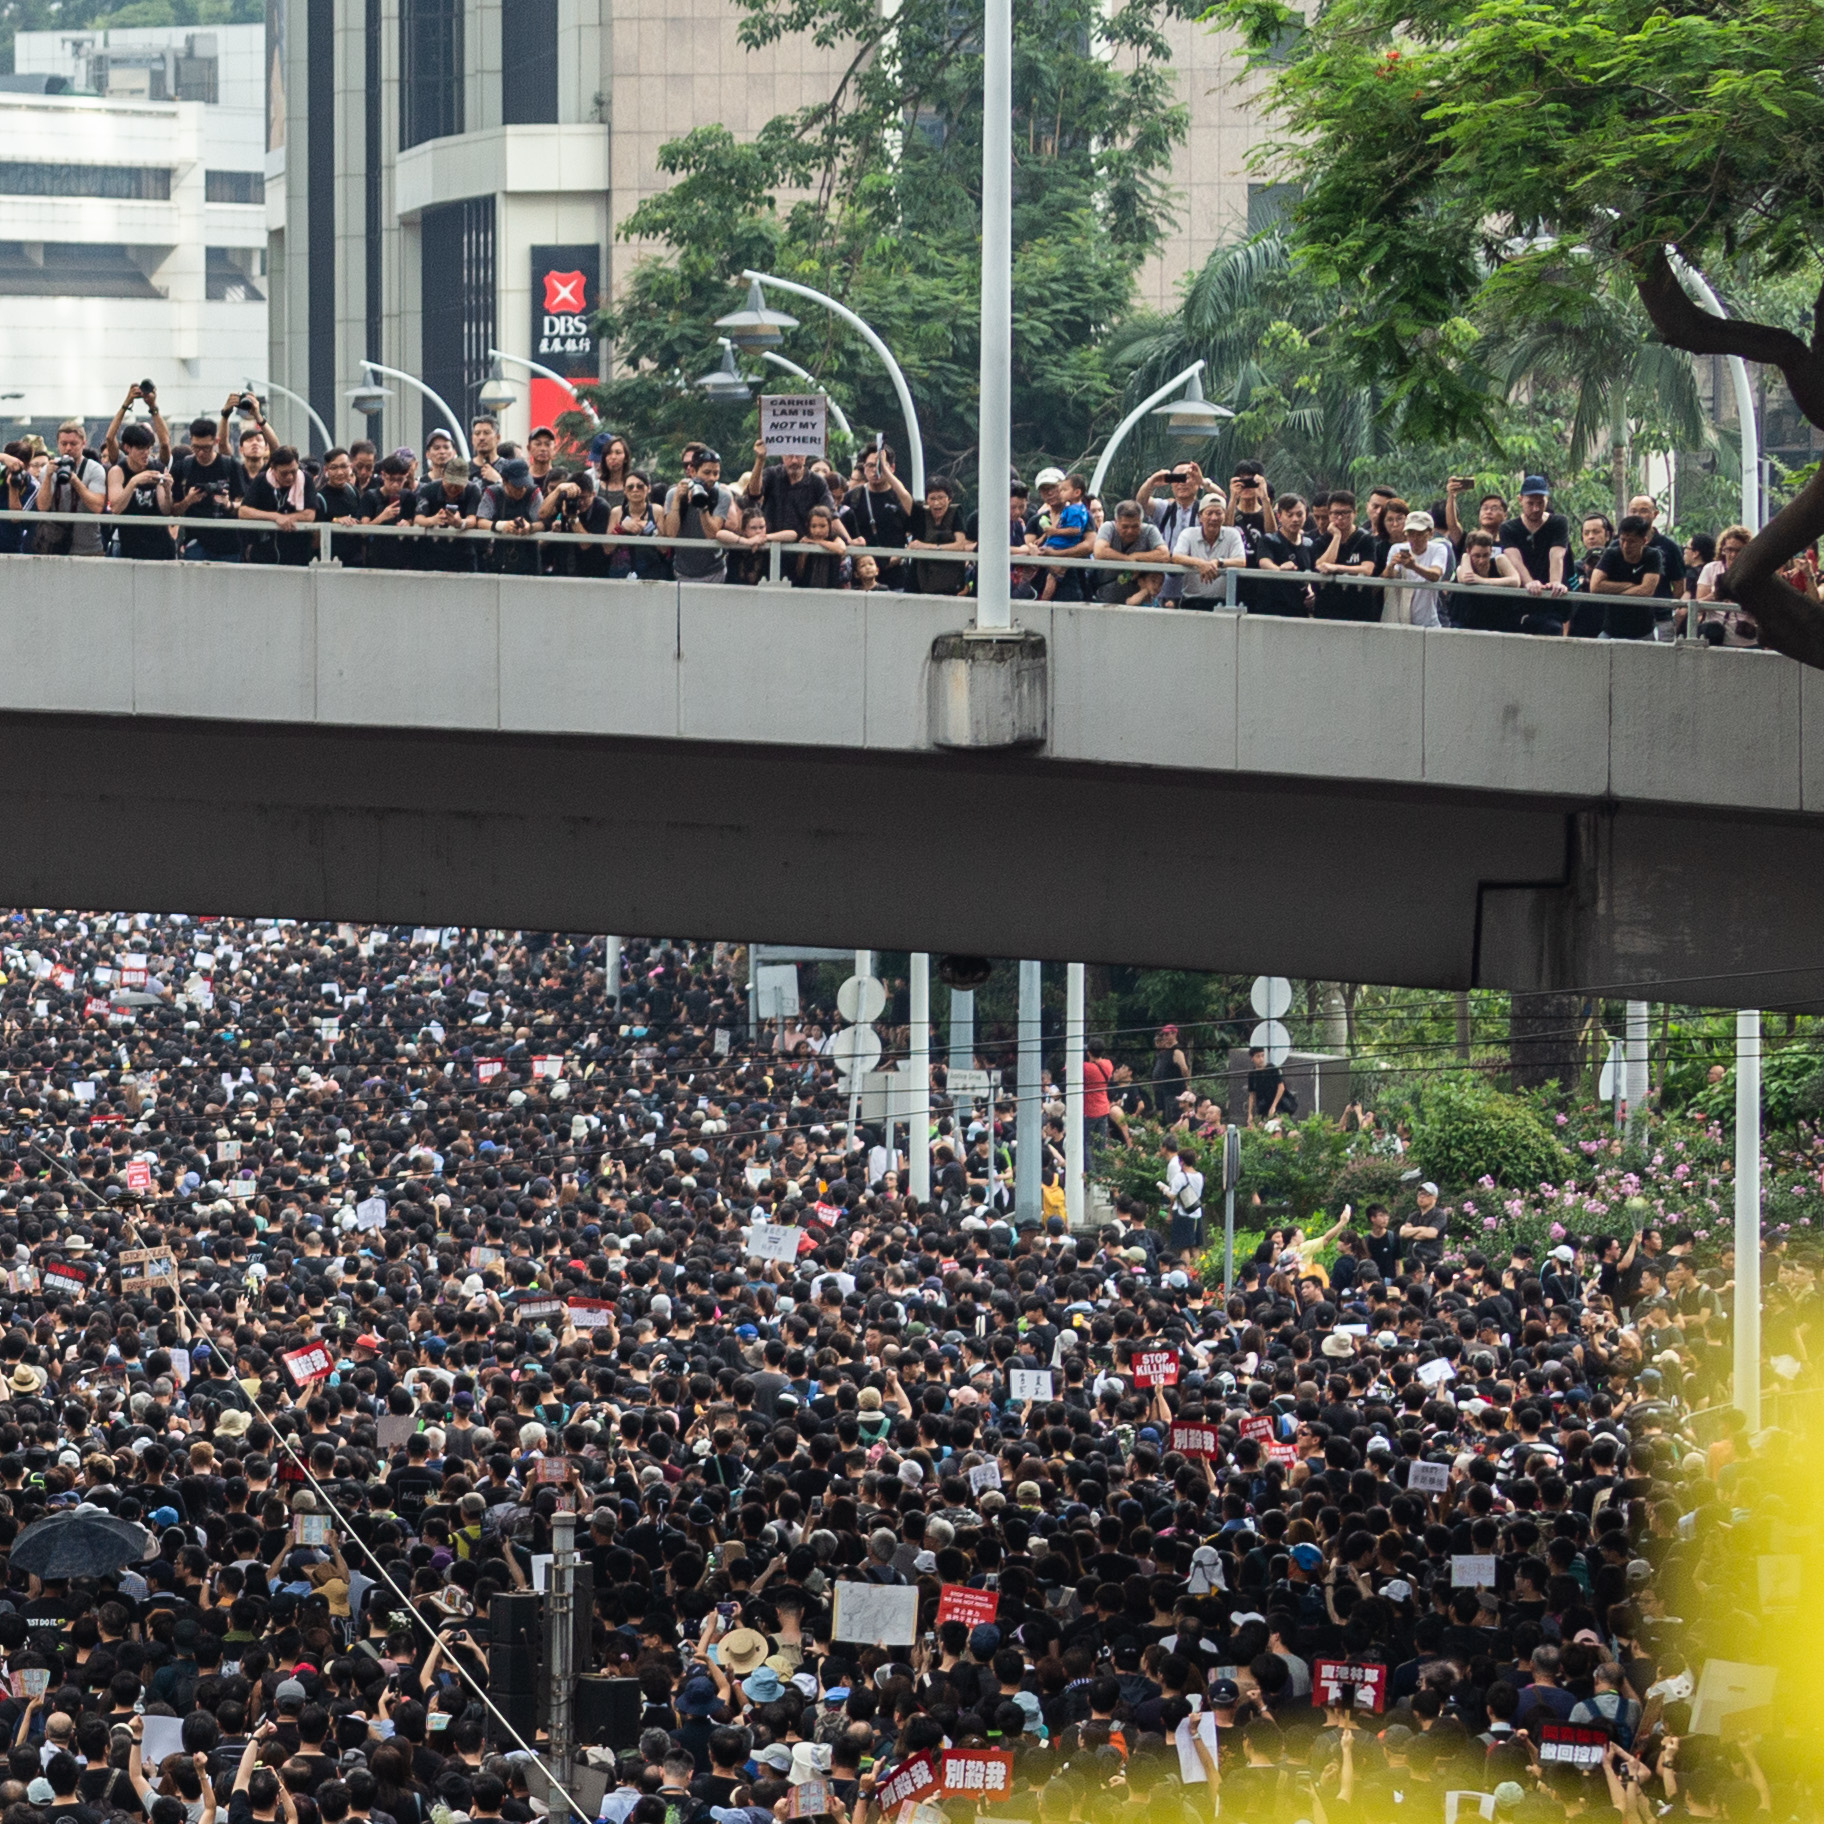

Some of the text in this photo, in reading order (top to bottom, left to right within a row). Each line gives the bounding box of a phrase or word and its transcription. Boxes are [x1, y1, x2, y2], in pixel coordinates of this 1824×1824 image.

[543, 315, 588, 337] DBS
[773, 408, 815, 416] LAM IS
[769, 421, 818, 430] NOT MY
[765, 435, 821, 445] MOTHER!
[1142, 1352, 1170, 1365] STOP
[1135, 1362, 1176, 1376] KILLING
[1151, 1374, 1165, 1385] US
[1174, 1428, 1215, 1453] 別殺我
[945, 1759, 1007, 1790] 別殺我
[880, 1758, 934, 1811] 別殺我
